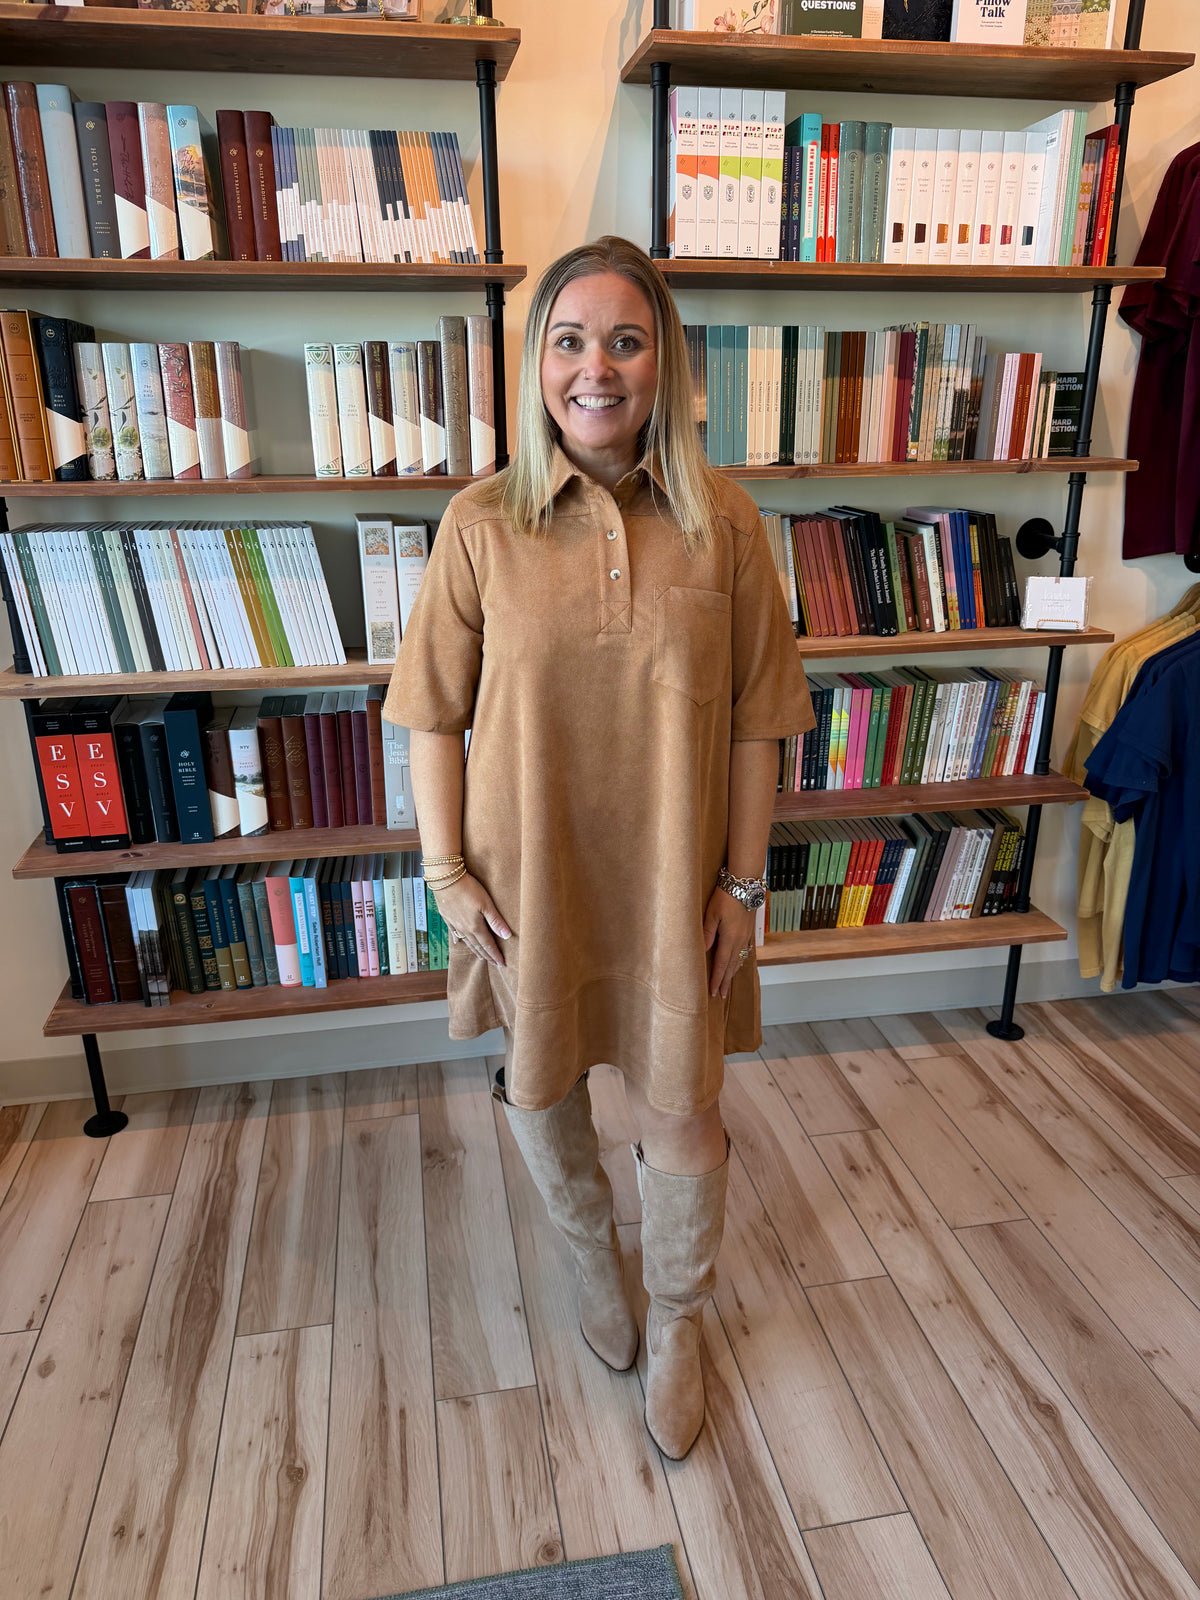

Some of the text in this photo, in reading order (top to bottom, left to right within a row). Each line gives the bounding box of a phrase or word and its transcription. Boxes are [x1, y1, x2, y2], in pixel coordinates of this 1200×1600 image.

[801, 0, 856, 10] QUESTIONS
[980, 7, 1005, 17] Talk
[90, 146, 104, 205] HOLY BIBLE
[878, 556, 886, 569] Family
[884, 589, 892, 603] Journal
[875, 589, 883, 603] Journal
[872, 694, 881, 711] LIVE
[882, 694, 890, 711] LIVE
[914, 695, 922, 717] FAMILIAR
[924, 694, 932, 716] FAMILIAR
[910, 717, 918, 741] STRANGER
[920, 717, 928, 741] STRANGER
[49, 745, 66, 761] E
[87, 743, 103, 759] E
[56, 774, 70, 790] S
[93, 772, 107, 788] S
[59, 802, 75, 817] V
[96, 800, 112, 815] V
[308, 892, 316, 904] NEXT
[323, 900, 331, 925] JESUS
[333, 900, 342, 925] JESUS
[344, 898, 353, 923] JESUS
[354, 901, 363, 919] LIFE
[365, 900, 373, 917] LIFE
[178, 910, 195, 971] EVERYDAY GOSPEL
